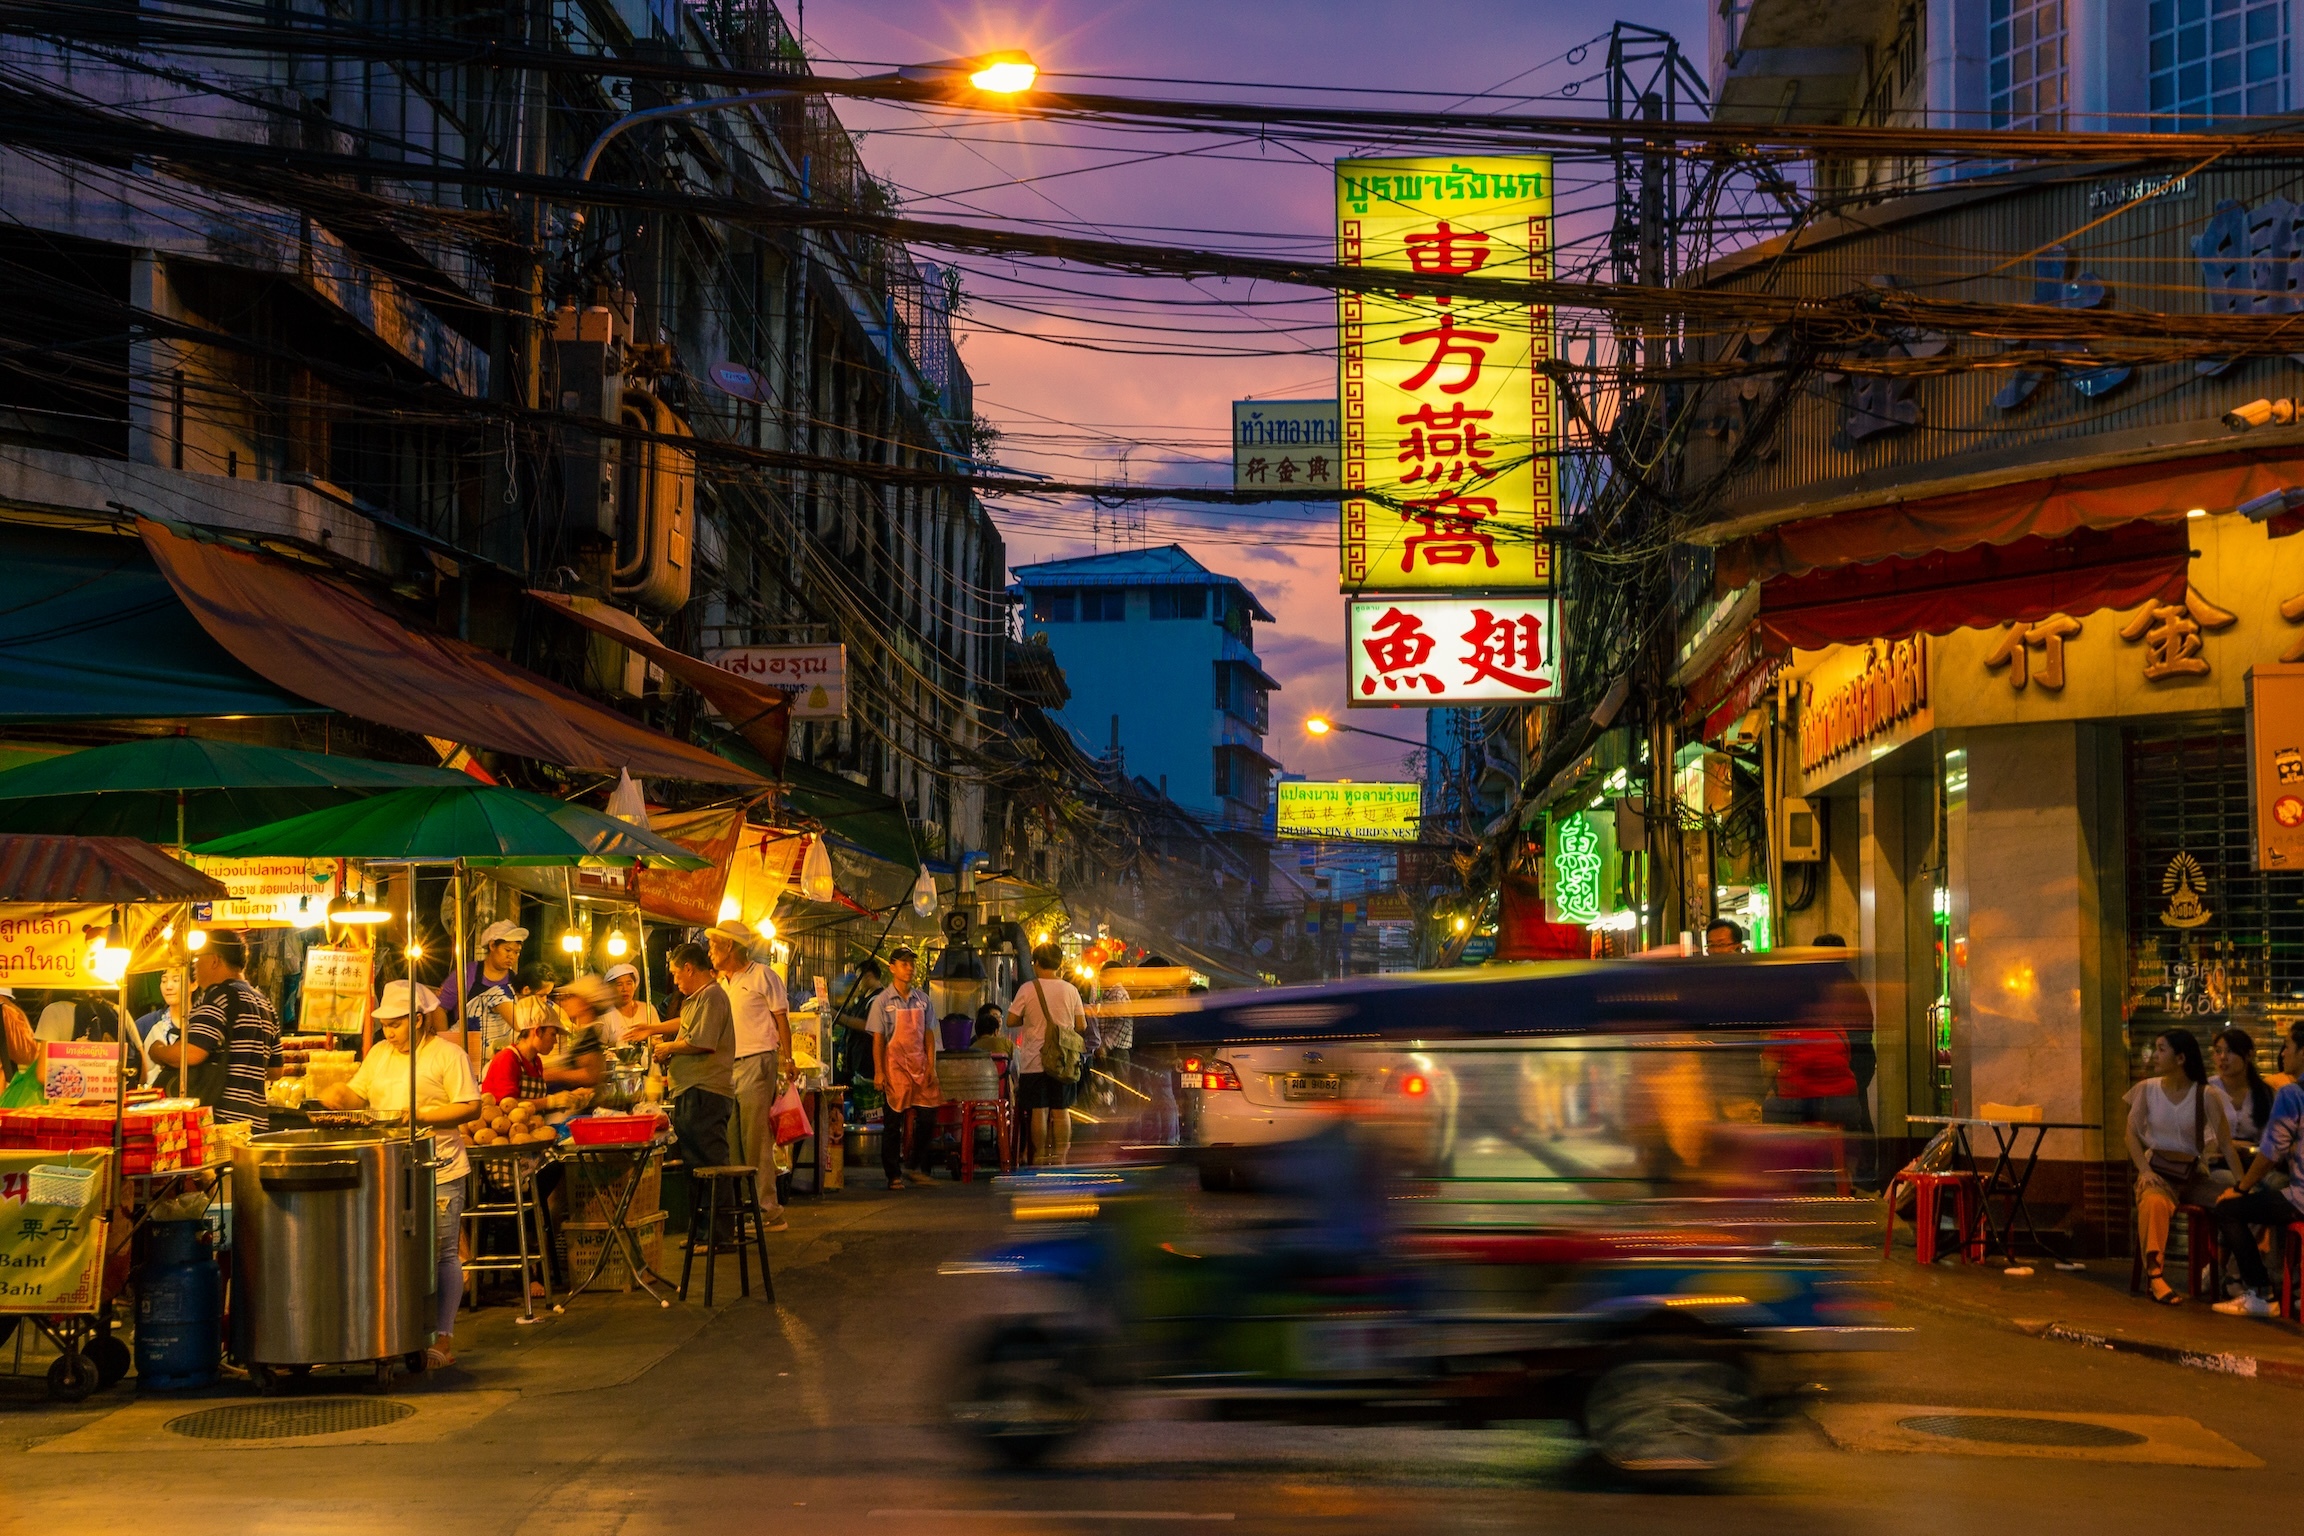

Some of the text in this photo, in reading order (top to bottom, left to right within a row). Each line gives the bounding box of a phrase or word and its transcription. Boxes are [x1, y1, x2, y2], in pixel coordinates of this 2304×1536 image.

[1344, 164, 1544, 213] บูรพารังนก
[1361, 607, 1553, 696] 魚翅
[1280, 786, 1419, 807] แปลงนาม หูฉลามรังนก
[1280, 826, 1417, 838] SHARK'S FIN & BIRD'S NEST
[0, 910, 71, 943] ลูกเล็ก
[0, 945, 76, 978] ลูกใหญ่
[18, 1218, 79, 1242] 栗子
[0, 1253, 47, 1268] Baht
[0, 1281, 43, 1296] Baht
